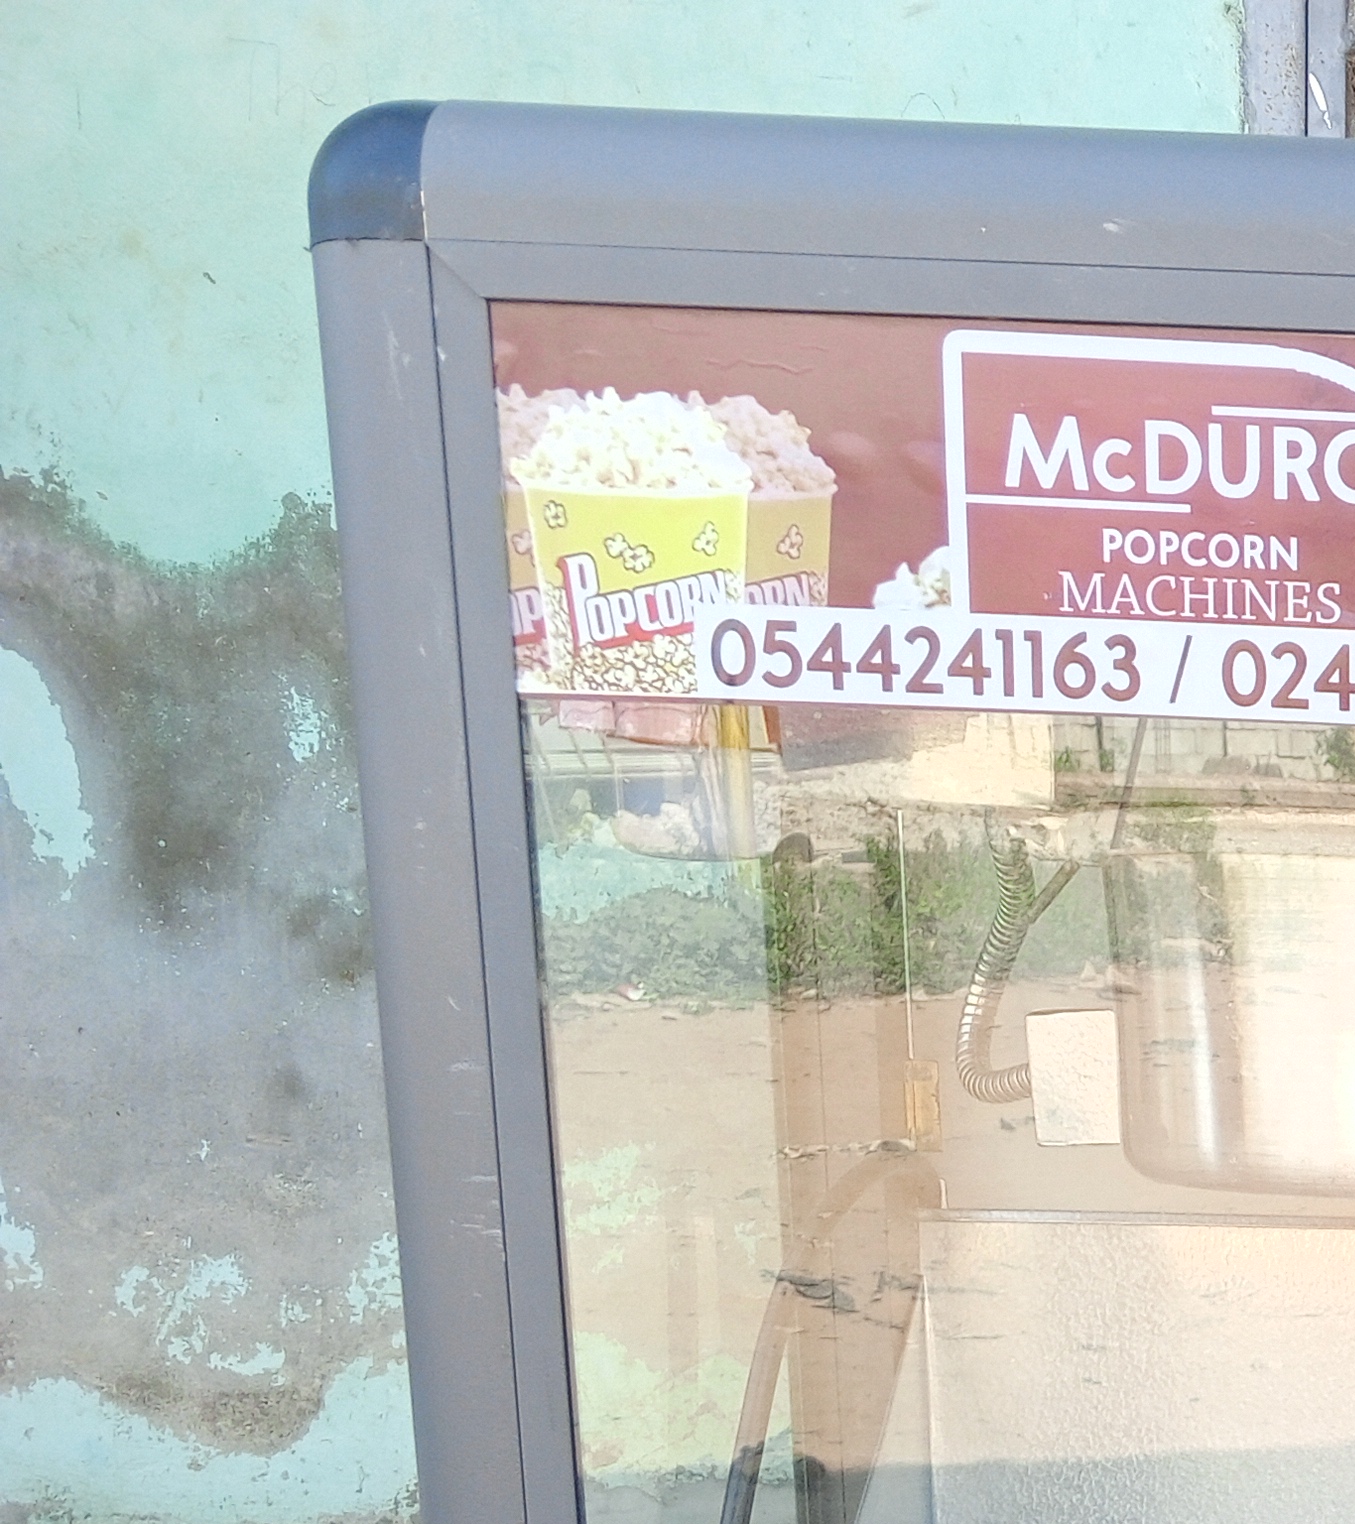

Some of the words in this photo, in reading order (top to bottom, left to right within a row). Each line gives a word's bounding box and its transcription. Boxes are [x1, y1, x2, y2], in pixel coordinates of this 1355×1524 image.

[1102, 528, 1299, 571] POPCORN
[1058, 570, 1342, 624] MACHINES
[710, 618, 1140, 702] 0544241163
